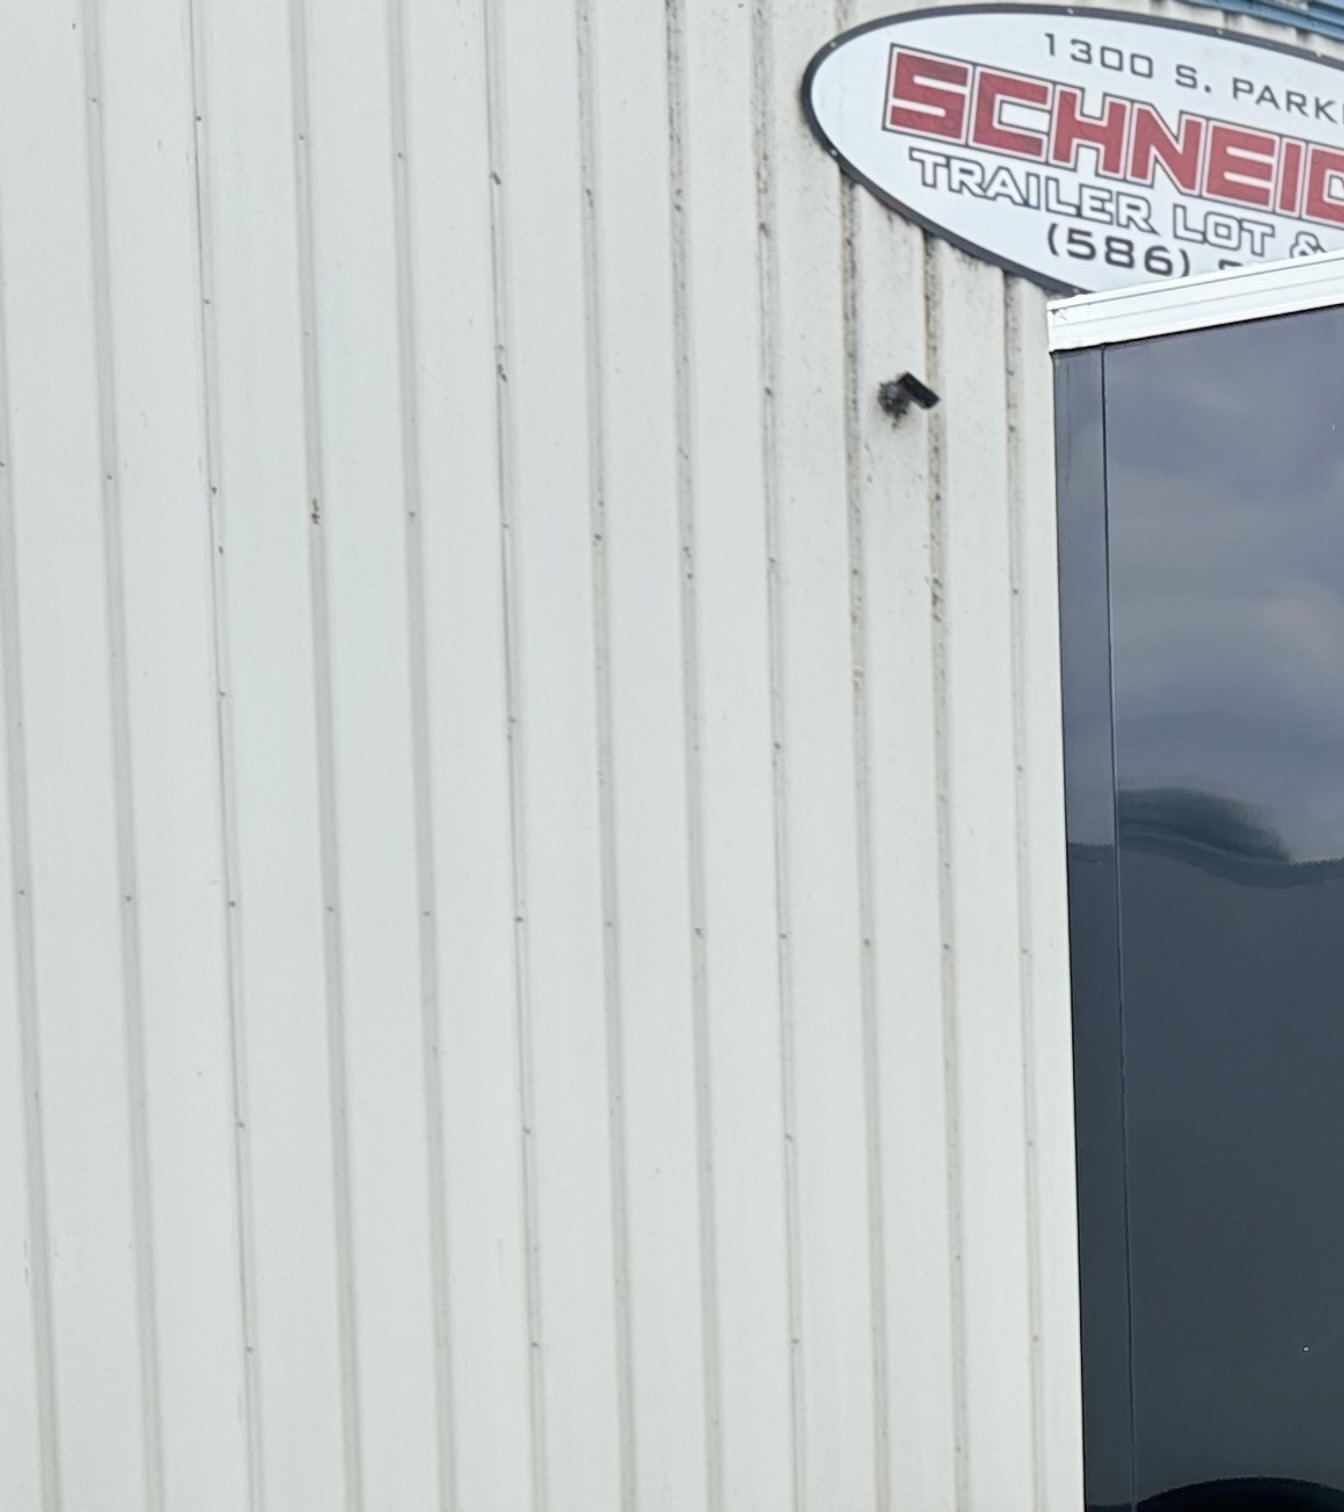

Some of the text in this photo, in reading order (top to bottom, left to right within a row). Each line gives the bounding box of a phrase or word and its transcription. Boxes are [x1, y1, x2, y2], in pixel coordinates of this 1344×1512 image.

[1044, 32, 1154, 79] 1300
[1175, 64, 1212, 93] S.
[909, 146, 1159, 236] TRAILER
[1173, 202, 1275, 258] LOT
[1047, 222, 1191, 278] (586)
